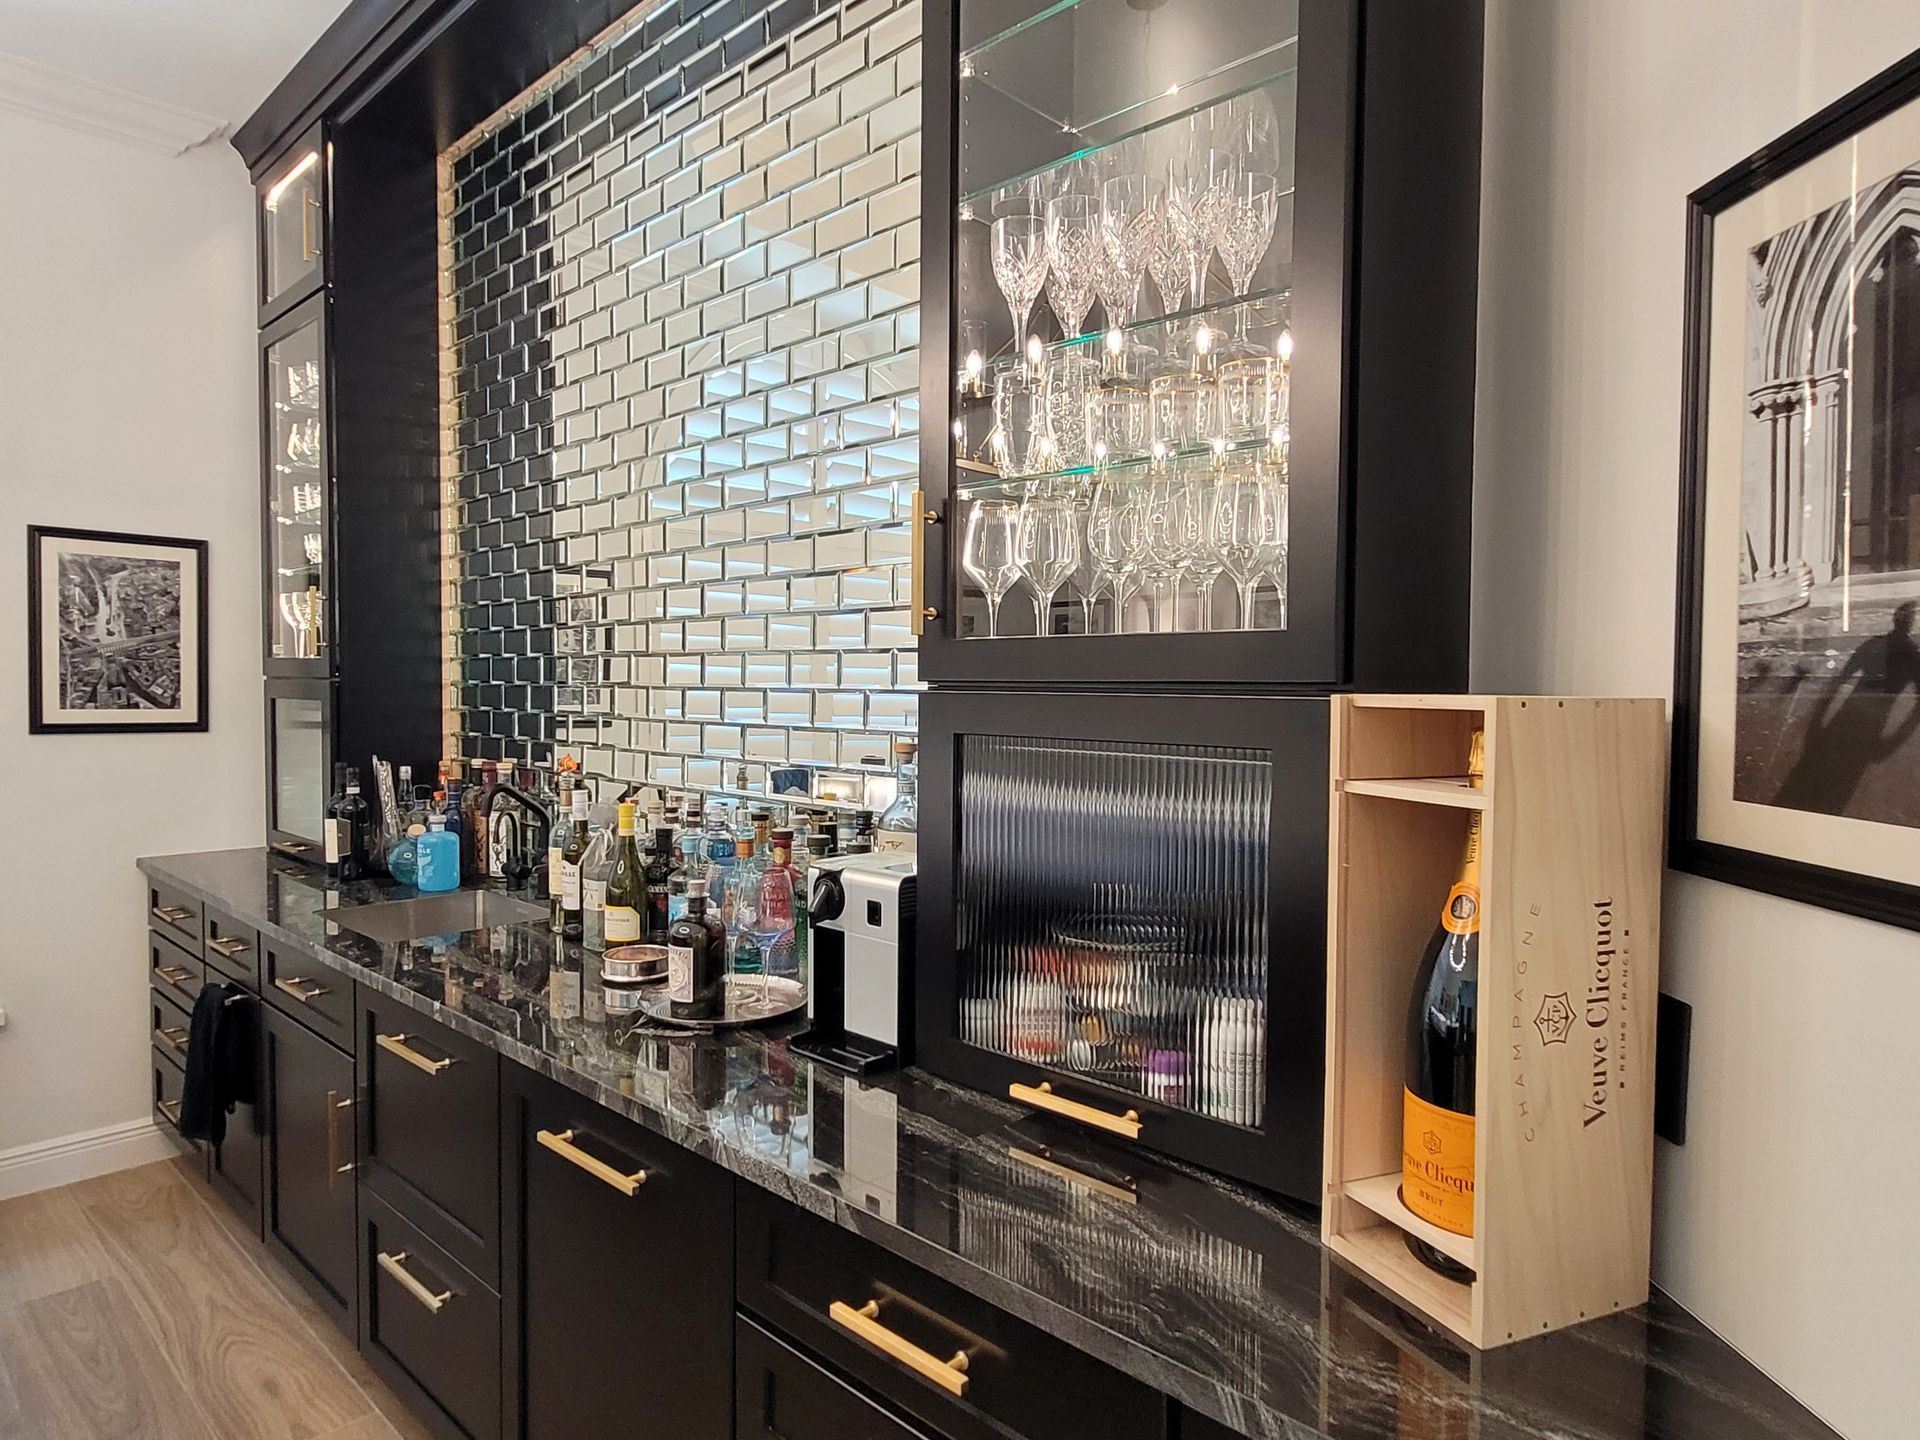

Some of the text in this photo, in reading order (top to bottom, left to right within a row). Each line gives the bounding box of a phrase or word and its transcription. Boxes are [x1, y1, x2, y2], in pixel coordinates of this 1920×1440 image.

[1469, 811, 1482, 836] Clicq
[1512, 902, 1542, 1142] CHAMPAGNE
[1583, 896, 1616, 1128] Veuve Clicquot
[1619, 948, 1630, 1072] REIMS FRANCE
[1418, 1187, 1445, 1207] BRUT
[1425, 1160, 1475, 1194] Clicqu
